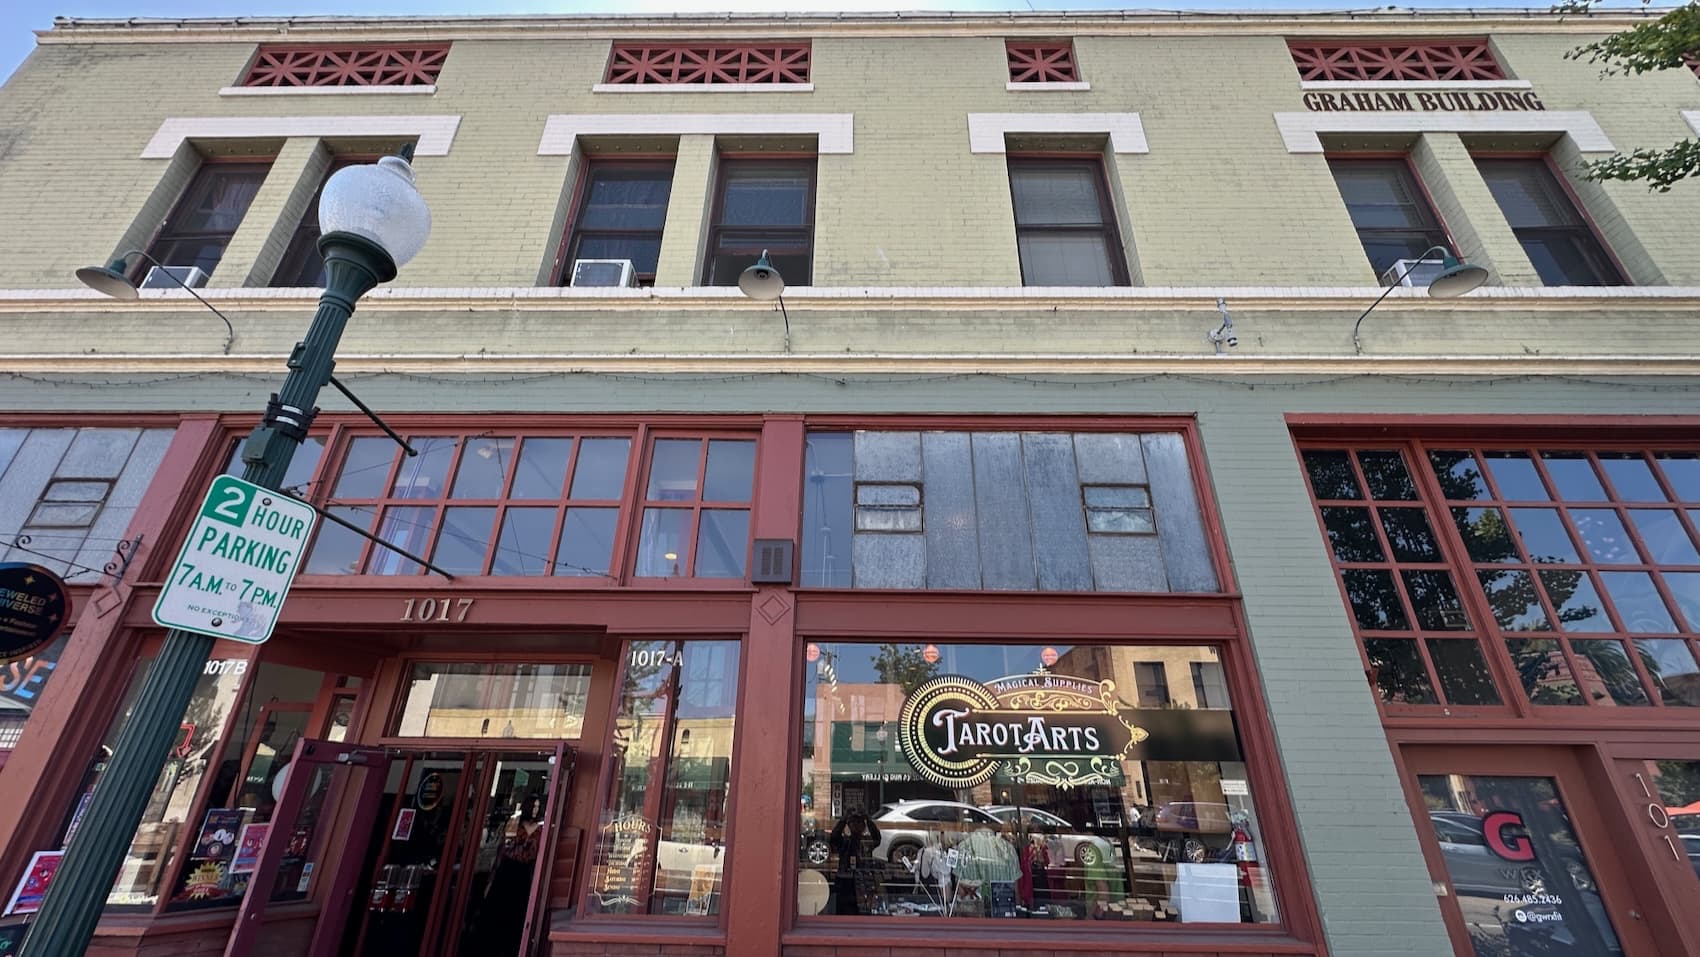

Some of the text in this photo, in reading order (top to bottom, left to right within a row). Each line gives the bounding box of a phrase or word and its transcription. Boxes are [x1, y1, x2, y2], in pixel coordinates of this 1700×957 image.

[1302, 91, 1545, 112] GRAHAM BUILDING
[214, 486, 304, 540] 2 HOUR
[197, 526, 292, 575] PARKING
[225, 582, 237, 592] TO
[0, 596, 44, 616] IVERSE
[187, 604, 200, 612] NO
[400, 598, 474, 622] 1017
[631, 650, 684, 667] 1017-A
[994, 677, 1093, 695] MAGICAL SUPPLIES
[614, 817, 652, 834] HOURS
[1483, 811, 1536, 862] G
[1503, 894, 1562, 905] 626.485.2436
